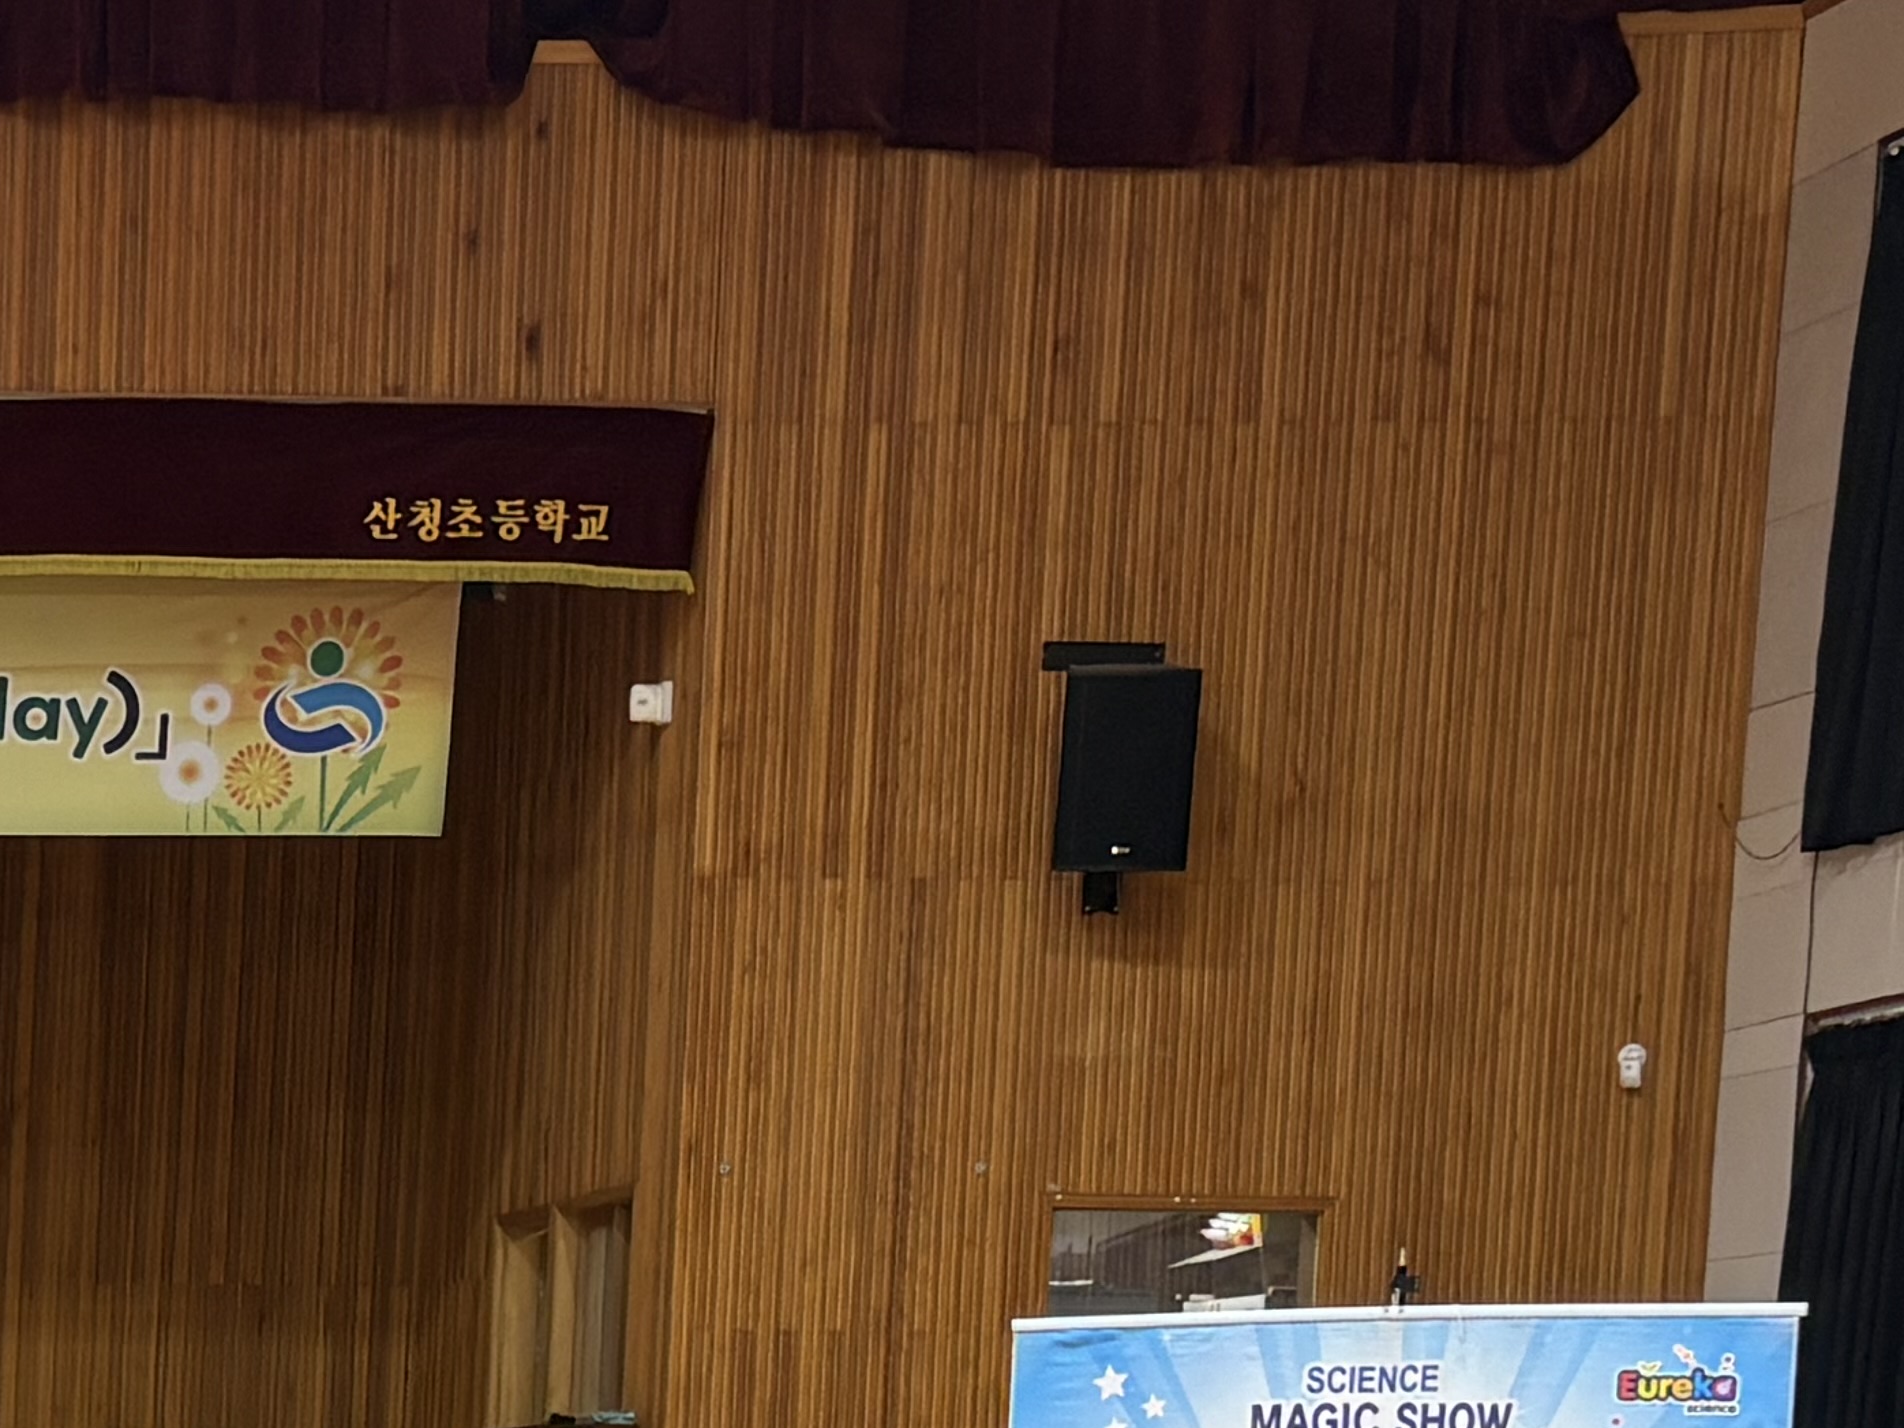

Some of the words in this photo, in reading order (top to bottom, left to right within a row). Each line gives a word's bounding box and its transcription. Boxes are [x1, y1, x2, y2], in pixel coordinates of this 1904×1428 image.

[363, 497, 610, 544] 산청초등학교
[1306, 1364, 1440, 1394] SCIENCE
[1618, 1368, 1737, 1401] Eureka
